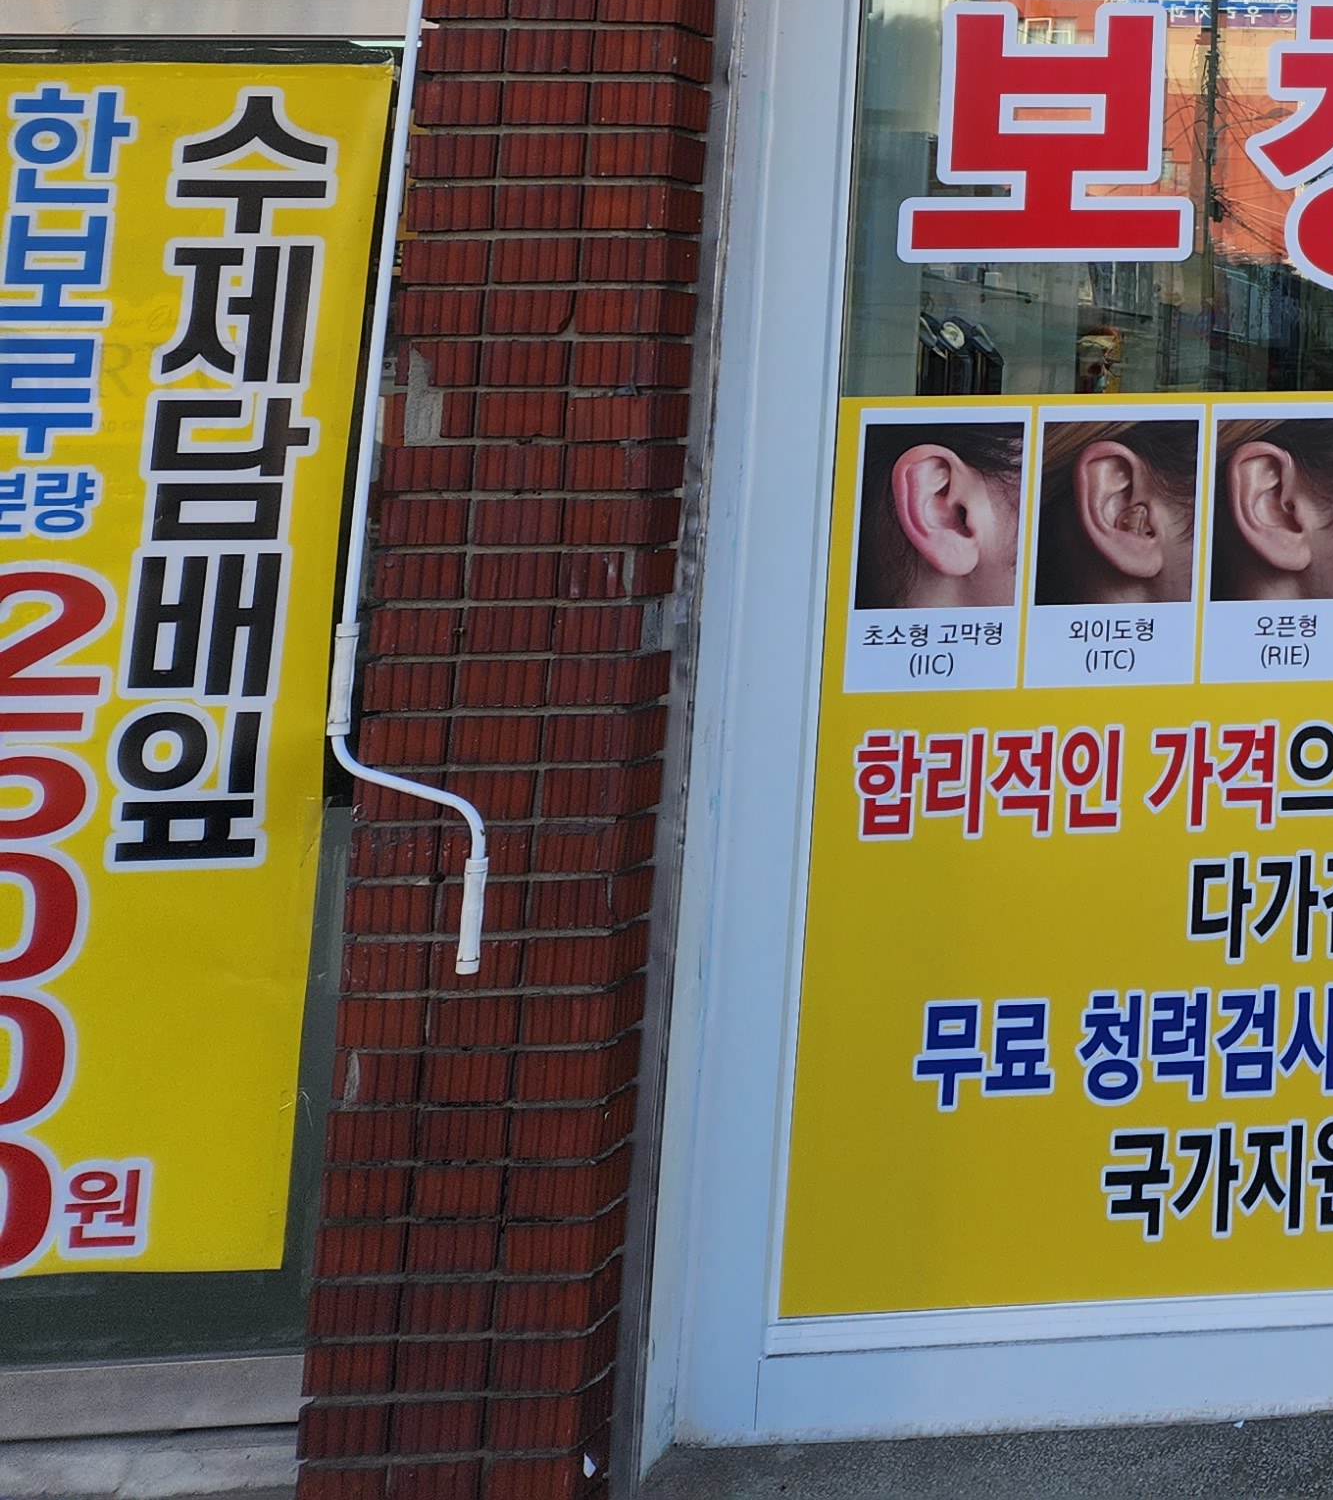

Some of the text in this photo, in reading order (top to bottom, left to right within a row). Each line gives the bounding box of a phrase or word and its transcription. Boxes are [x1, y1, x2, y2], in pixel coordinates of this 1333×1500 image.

[0, 87, 132, 455] 한보루
[114, 95, 328, 863] 수제담배잎
[862, 621, 1003, 649] 초소형 고막형
[1068, 618, 1155, 643] 외이도형
[1255, 614, 1318, 639] 오픈형
[909, 651, 954, 677] (IIC)
[1085, 647, 1135, 673] (ITC)
[1260, 643, 1310, 668] (RIE)
[853, 728, 1123, 842] 합리적인
[914, 997, 1055, 1111] 무료
